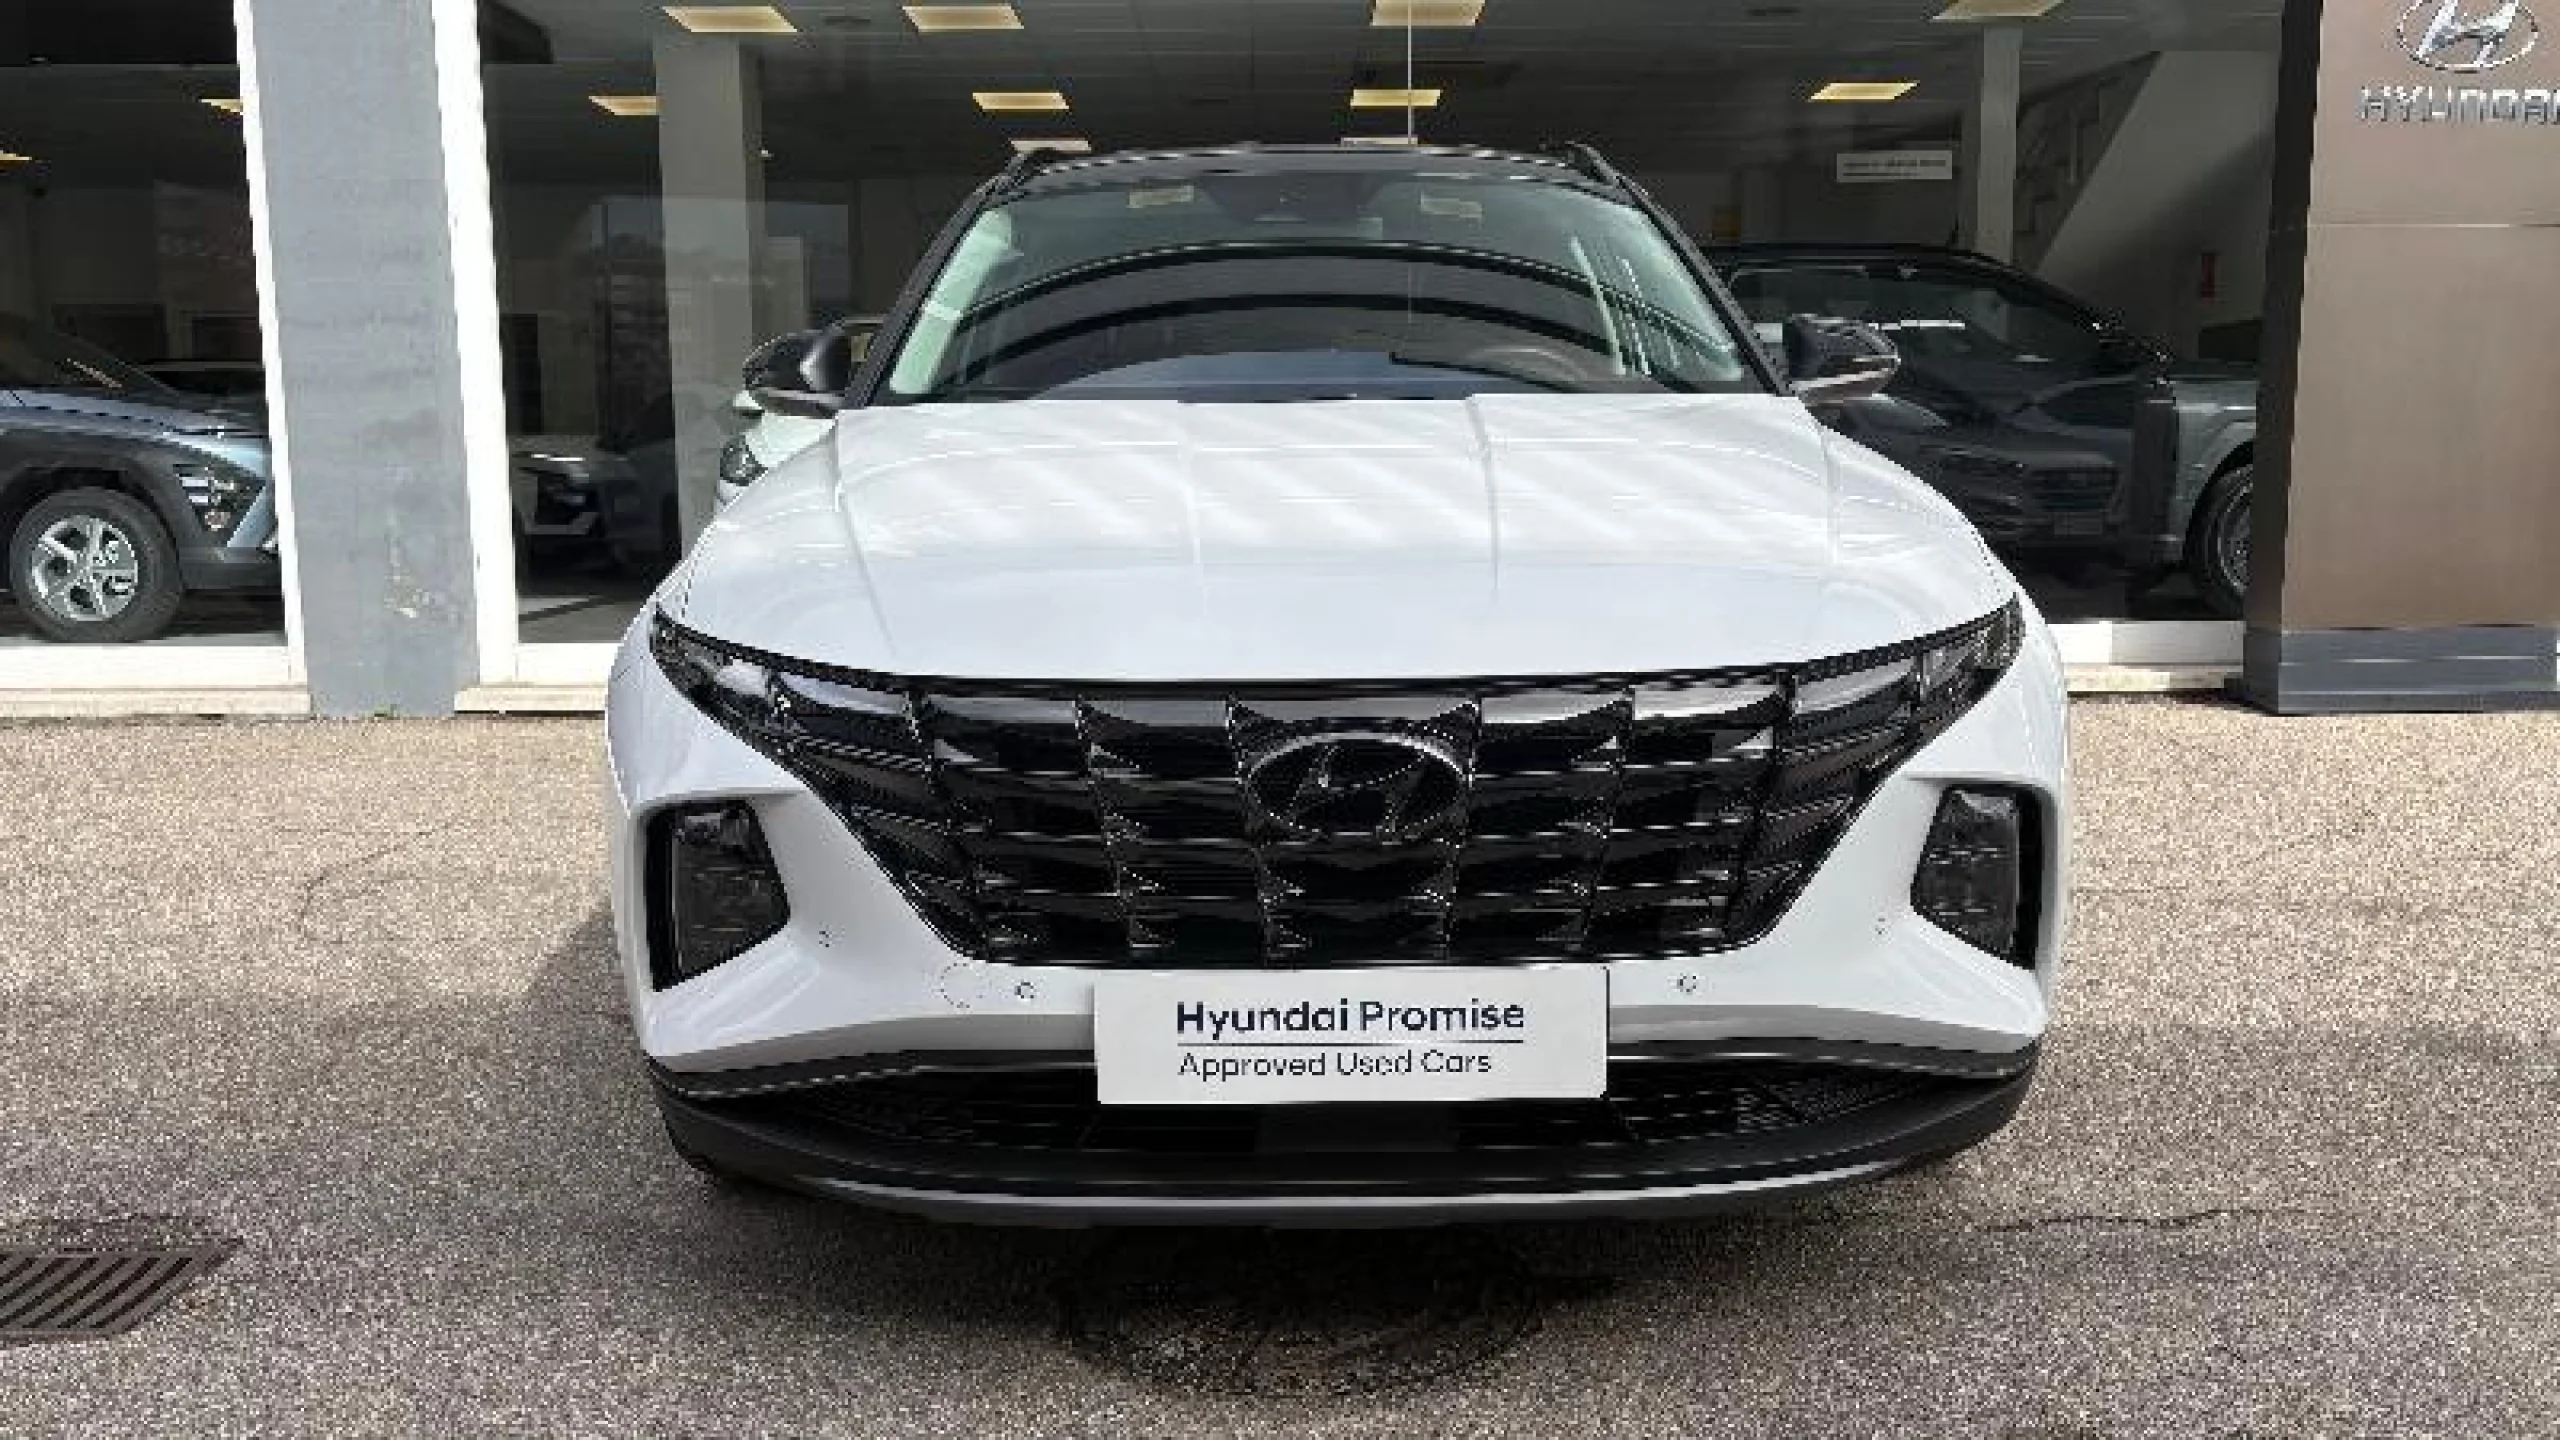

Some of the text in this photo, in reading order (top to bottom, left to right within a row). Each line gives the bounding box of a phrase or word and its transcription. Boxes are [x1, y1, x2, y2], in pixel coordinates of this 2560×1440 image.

[1177, 998, 1525, 1040] Hyundai Promise
[1178, 1048, 1492, 1081] Approved Used Cars
